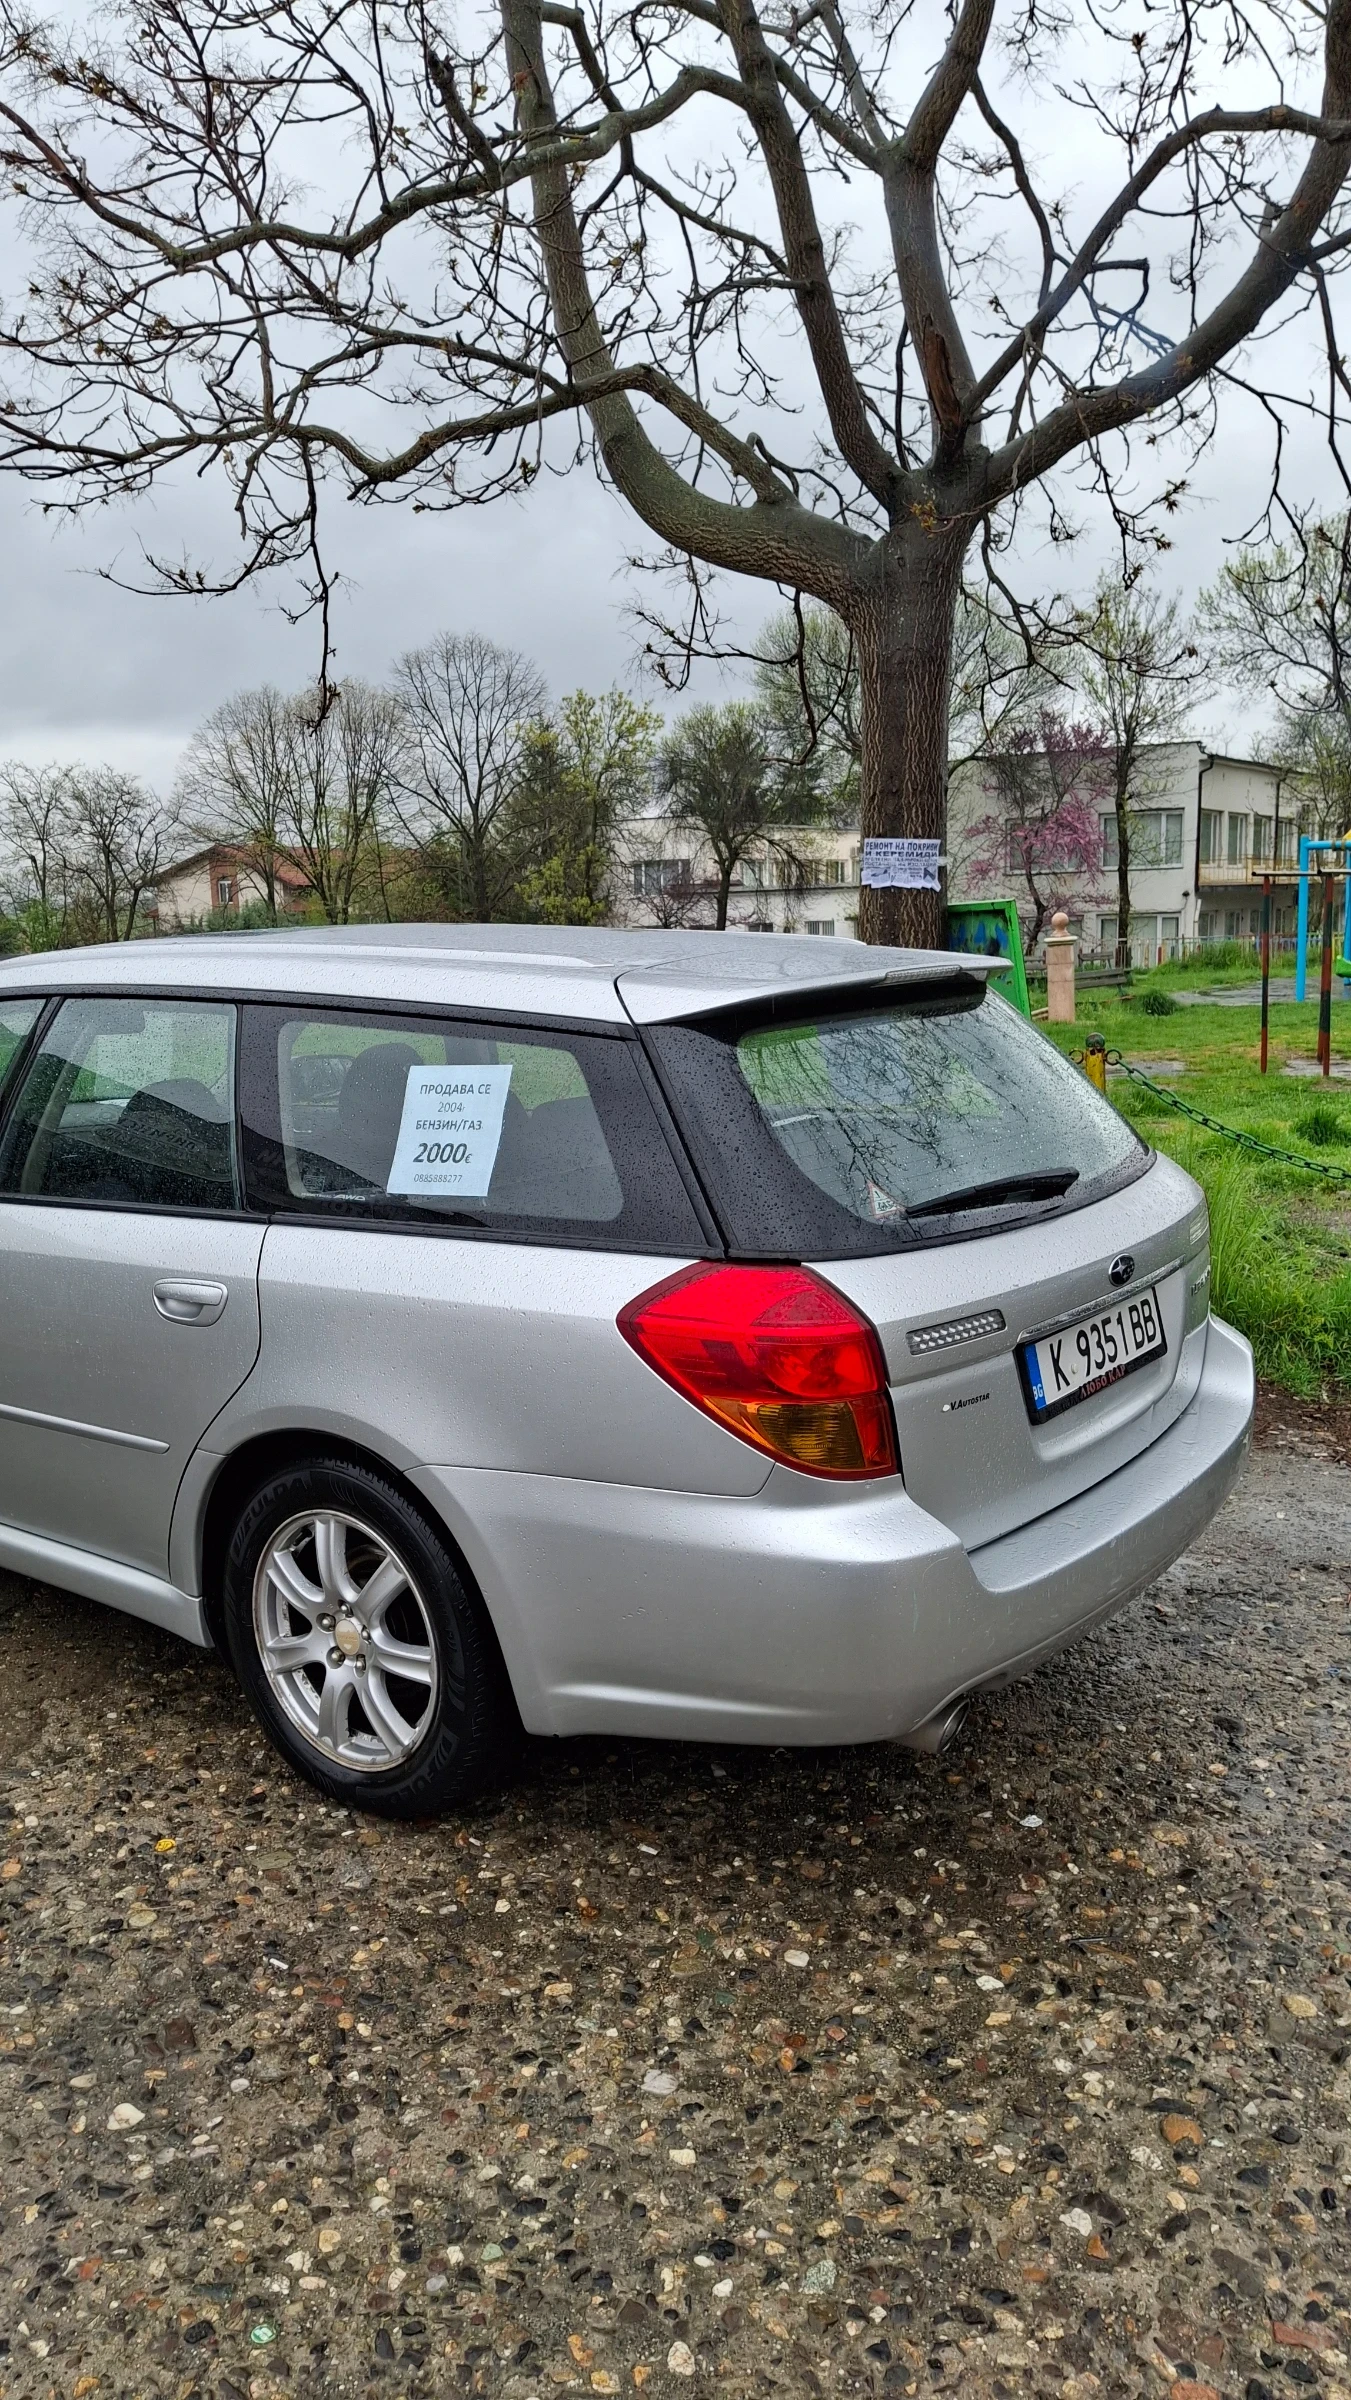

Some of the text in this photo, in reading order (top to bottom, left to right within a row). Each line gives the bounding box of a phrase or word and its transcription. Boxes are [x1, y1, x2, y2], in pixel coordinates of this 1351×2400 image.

[865, 842, 938, 851] РЕМОНТ НА ПОКРИВИ
[420, 1084, 492, 1096] ПРОДАВА СЕ
[416, 1119, 482, 1132] БЕНЗИН/ГАЗ
[413, 1142, 472, 1164] 2000€
[414, 1174, 462, 1182] 0885888277
[1050, 1338, 1070, 1392] K
[1080, 1364, 1126, 1400] ЛЮБО КАР
[1032, 1384, 1044, 1401] BG
[243, 1478, 307, 1534] FULDA
